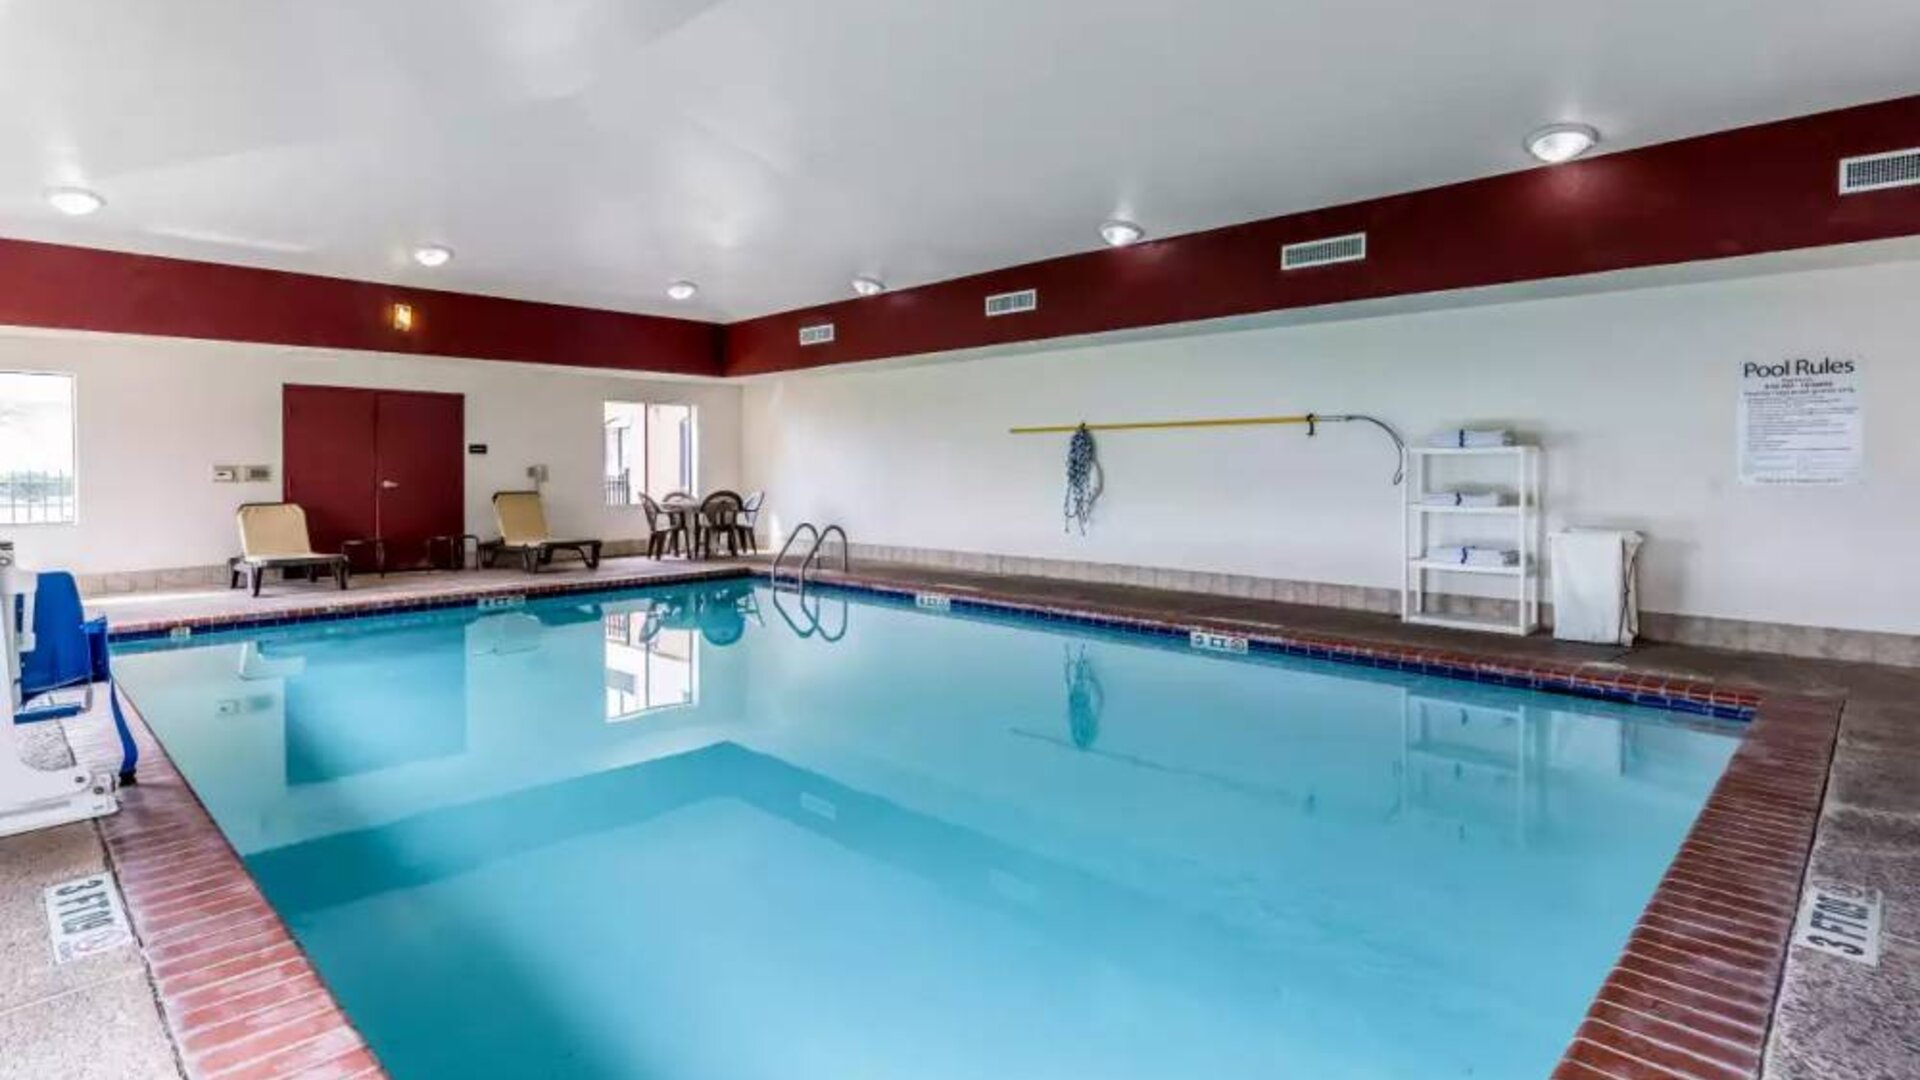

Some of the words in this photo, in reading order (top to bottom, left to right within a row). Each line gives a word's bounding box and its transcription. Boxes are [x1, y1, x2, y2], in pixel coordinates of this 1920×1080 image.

[1744, 360, 1790, 378] Pool
[1796, 357, 1855, 376] Rules
[1806, 935, 1864, 955] 3
